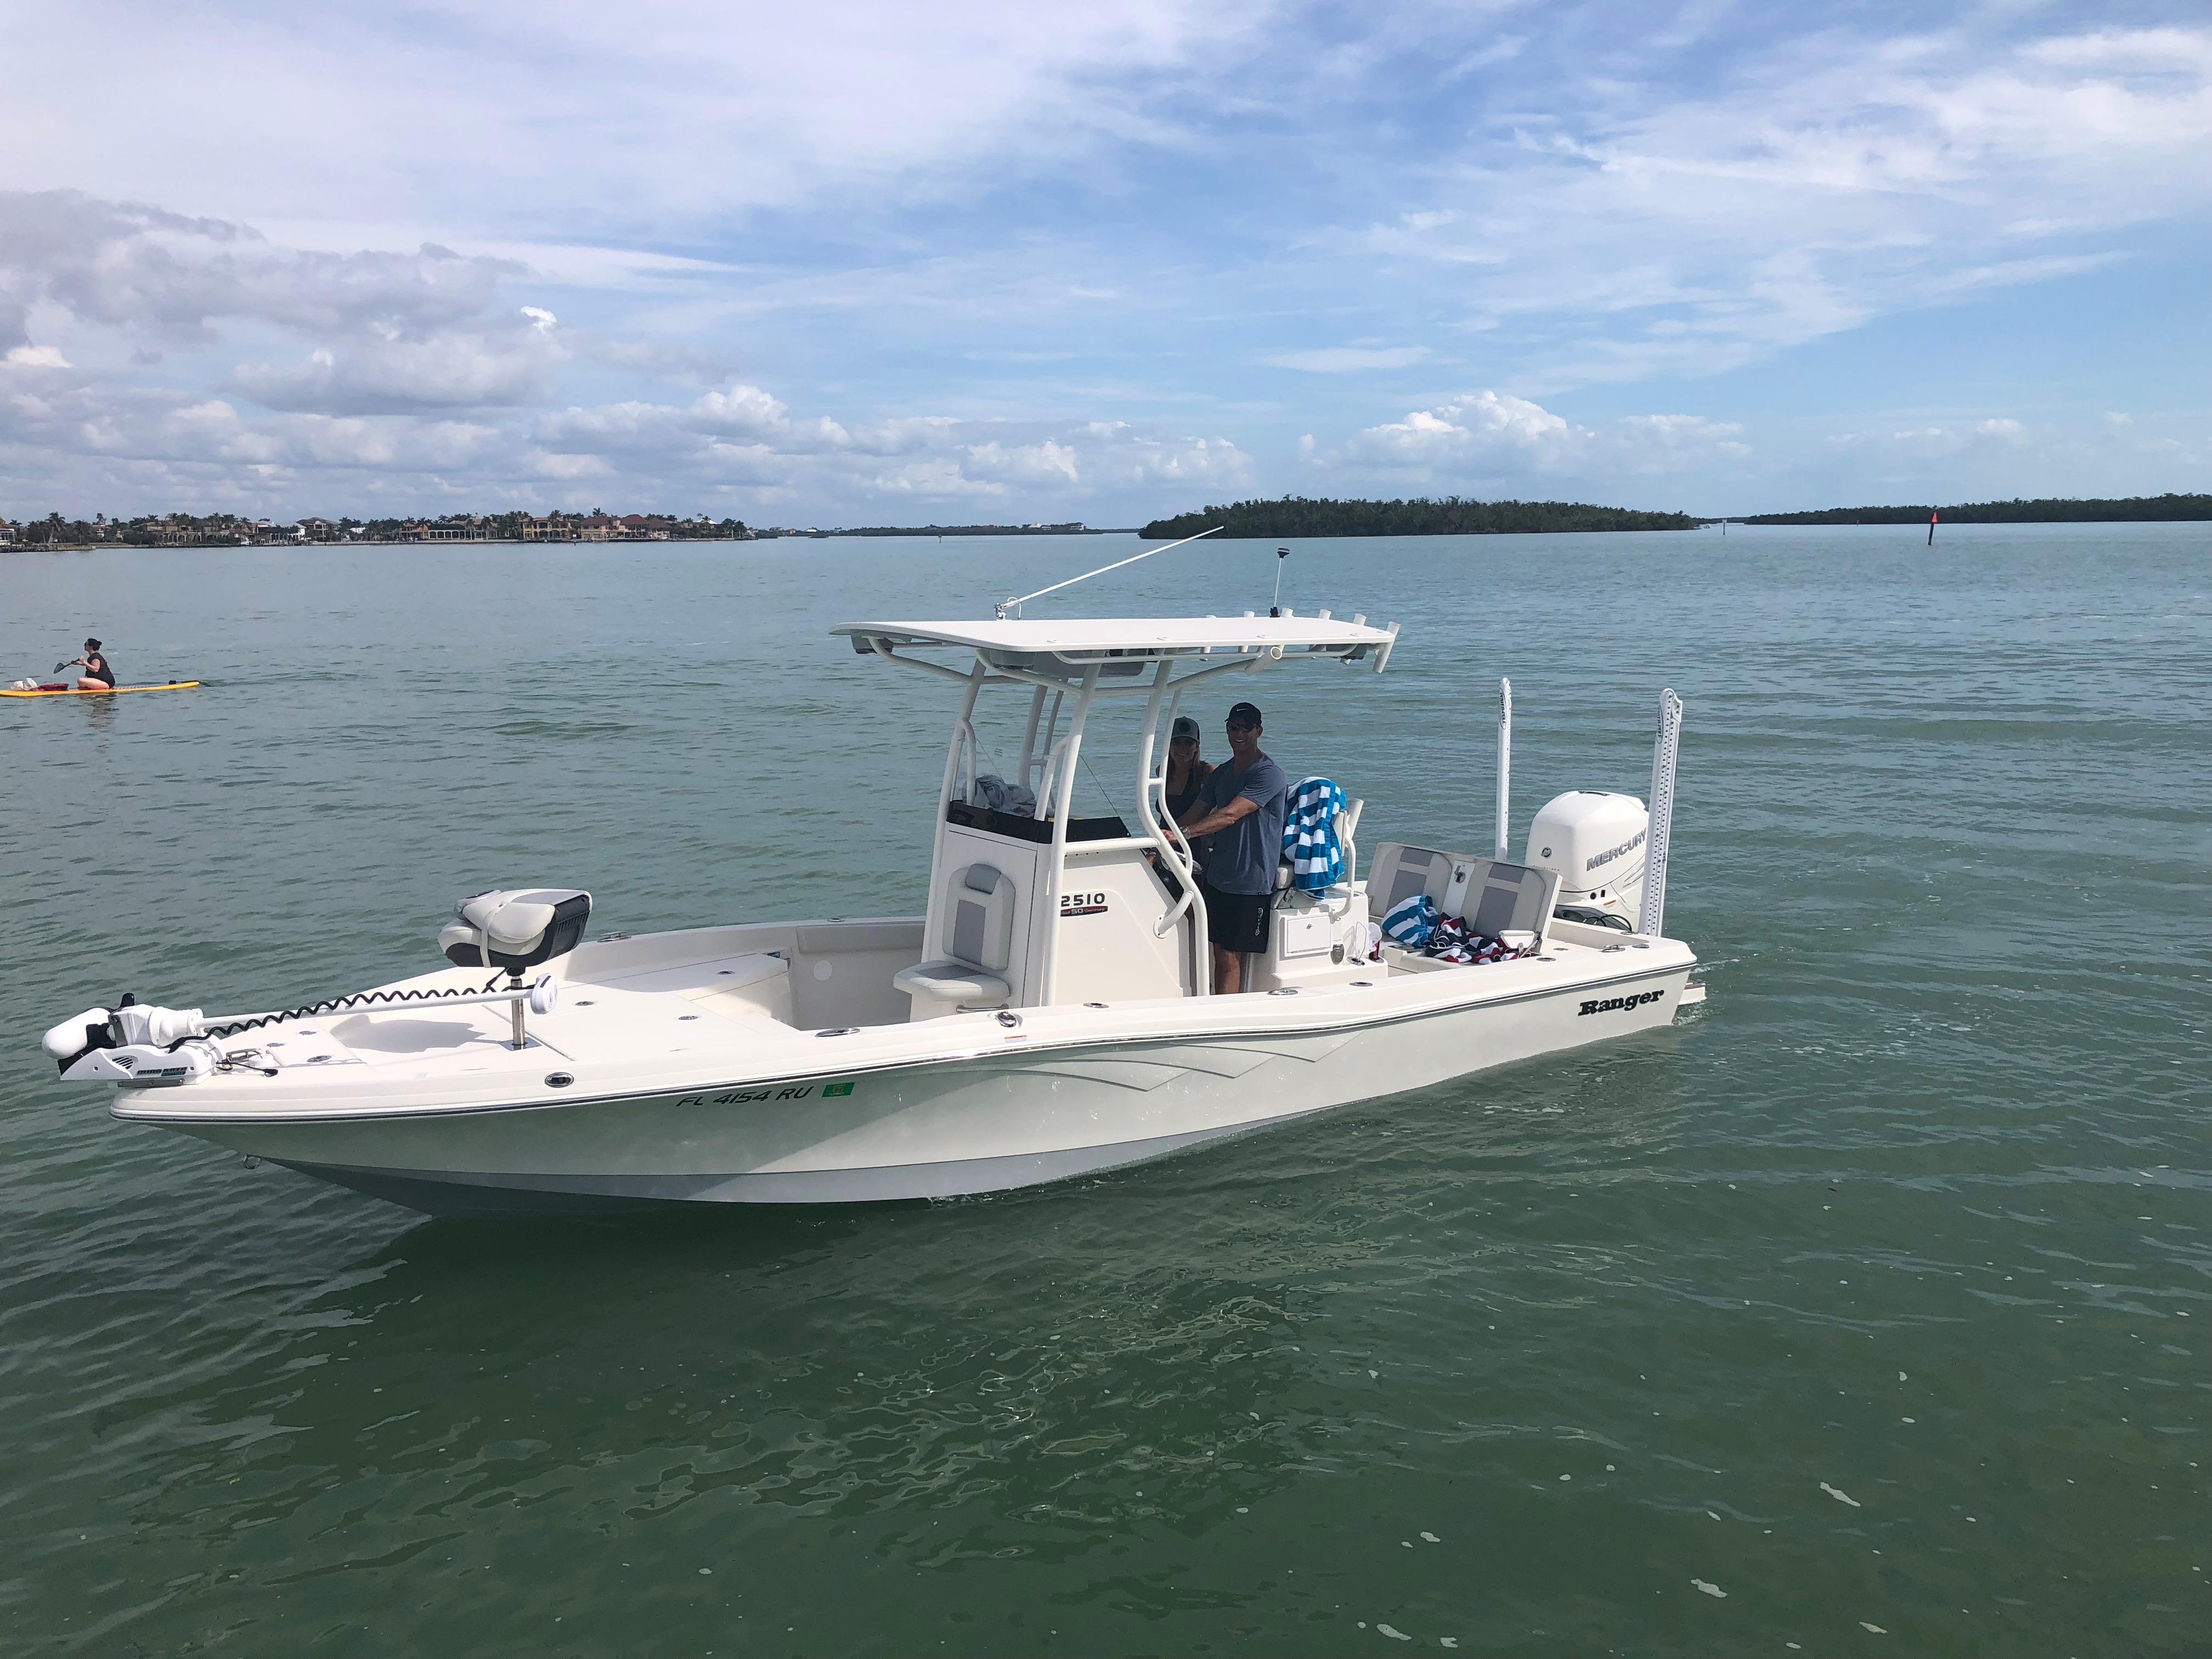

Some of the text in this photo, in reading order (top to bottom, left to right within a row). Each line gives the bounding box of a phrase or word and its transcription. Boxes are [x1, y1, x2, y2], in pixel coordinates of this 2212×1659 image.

[1586, 827, 1646, 871] MERCURY
[1061, 893, 1105, 907] 2510
[1578, 990, 1664, 1016] Ranger
[676, 1086, 814, 1107] FL 4154 RU
